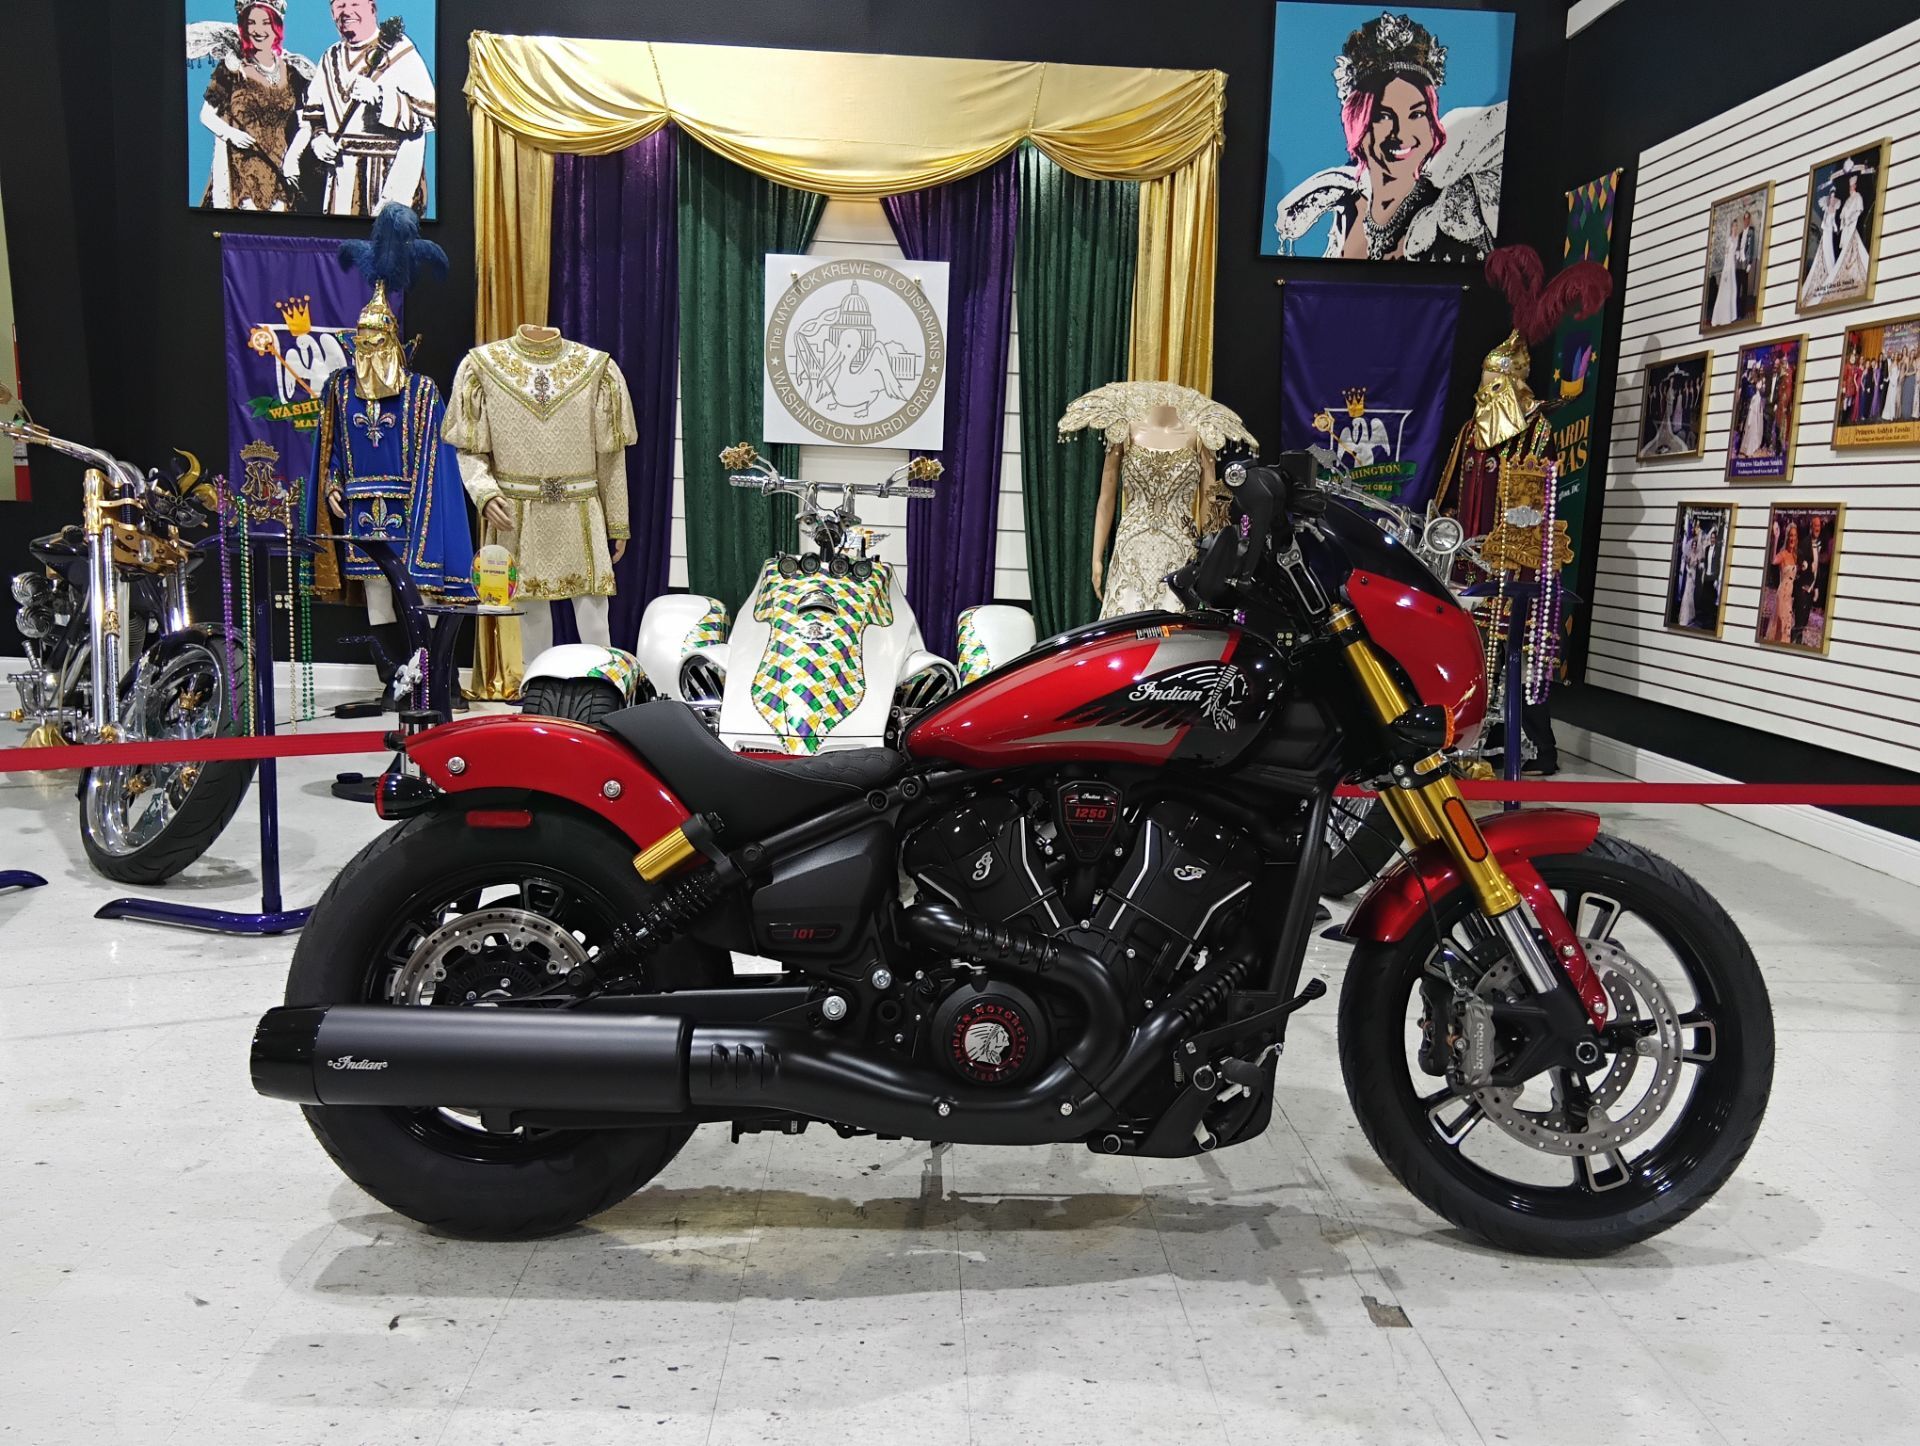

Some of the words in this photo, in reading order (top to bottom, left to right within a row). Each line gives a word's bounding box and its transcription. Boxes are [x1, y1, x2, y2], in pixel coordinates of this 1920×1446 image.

[769, 328, 783, 351] The
[776, 275, 820, 327] MYSTICK
[821, 263, 871, 278] KREWE
[874, 267, 887, 279] of
[888, 274, 941, 360] LOUISIANIANS
[268, 400, 320, 419] WASHI
[773, 370, 856, 441] WASHINGTON
[860, 415, 908, 441] MARDI
[906, 378, 937, 417] GRAS
[1556, 440, 1588, 478] RAS
[1128, 681, 1203, 701] Indian
[1074, 808, 1107, 818] 1250
[794, 929, 814, 938] 101
[1474, 1022, 1484, 1070] brembo
[332, 1055, 383, 1070] Indian
